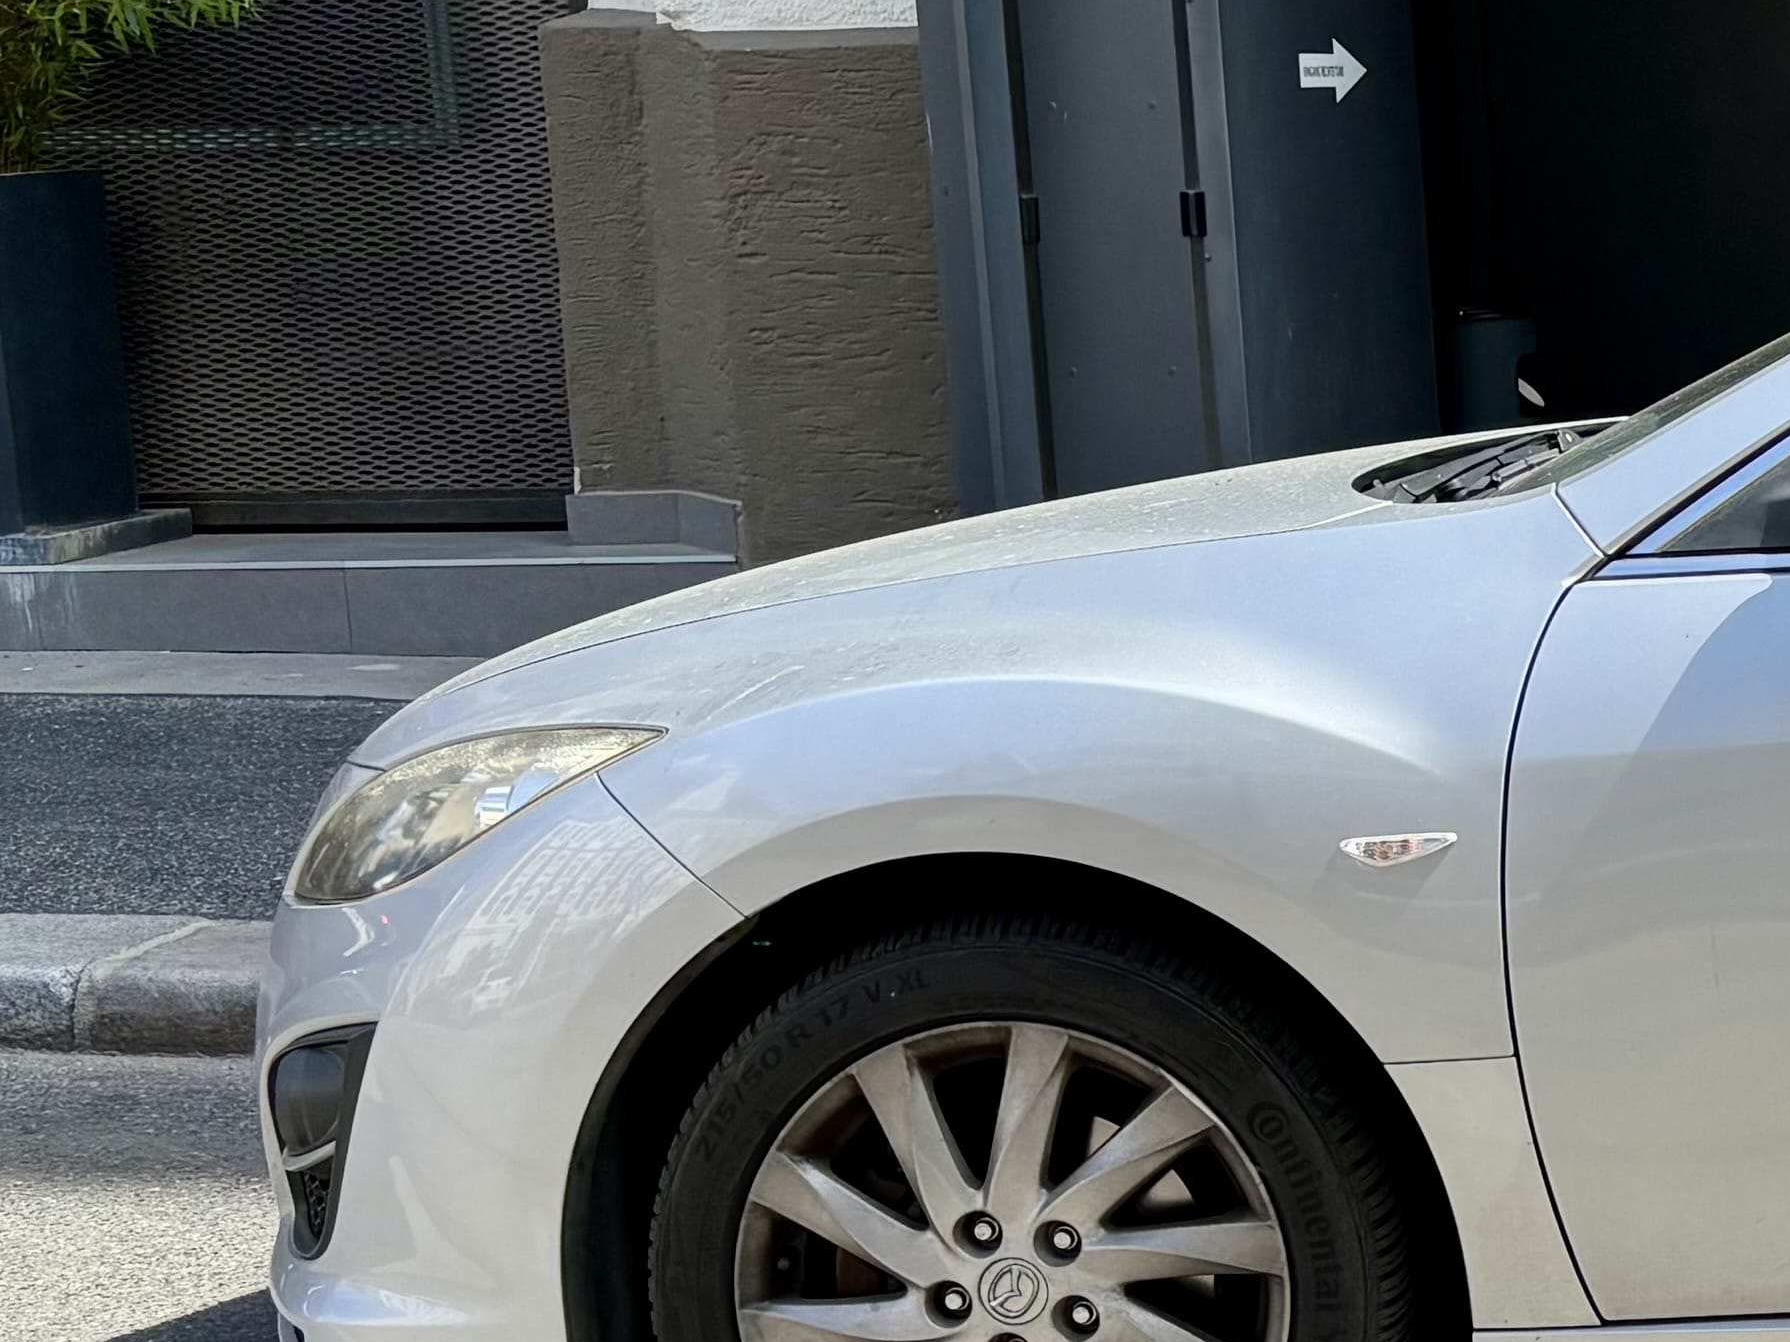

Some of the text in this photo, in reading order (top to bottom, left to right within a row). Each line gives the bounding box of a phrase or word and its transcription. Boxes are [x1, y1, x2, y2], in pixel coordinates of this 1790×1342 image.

[694, 1045, 783, 1163] 215/50
[785, 1022, 815, 1048] R
[815, 994, 850, 1028] 17
[1246, 1100, 1345, 1312] Continental
